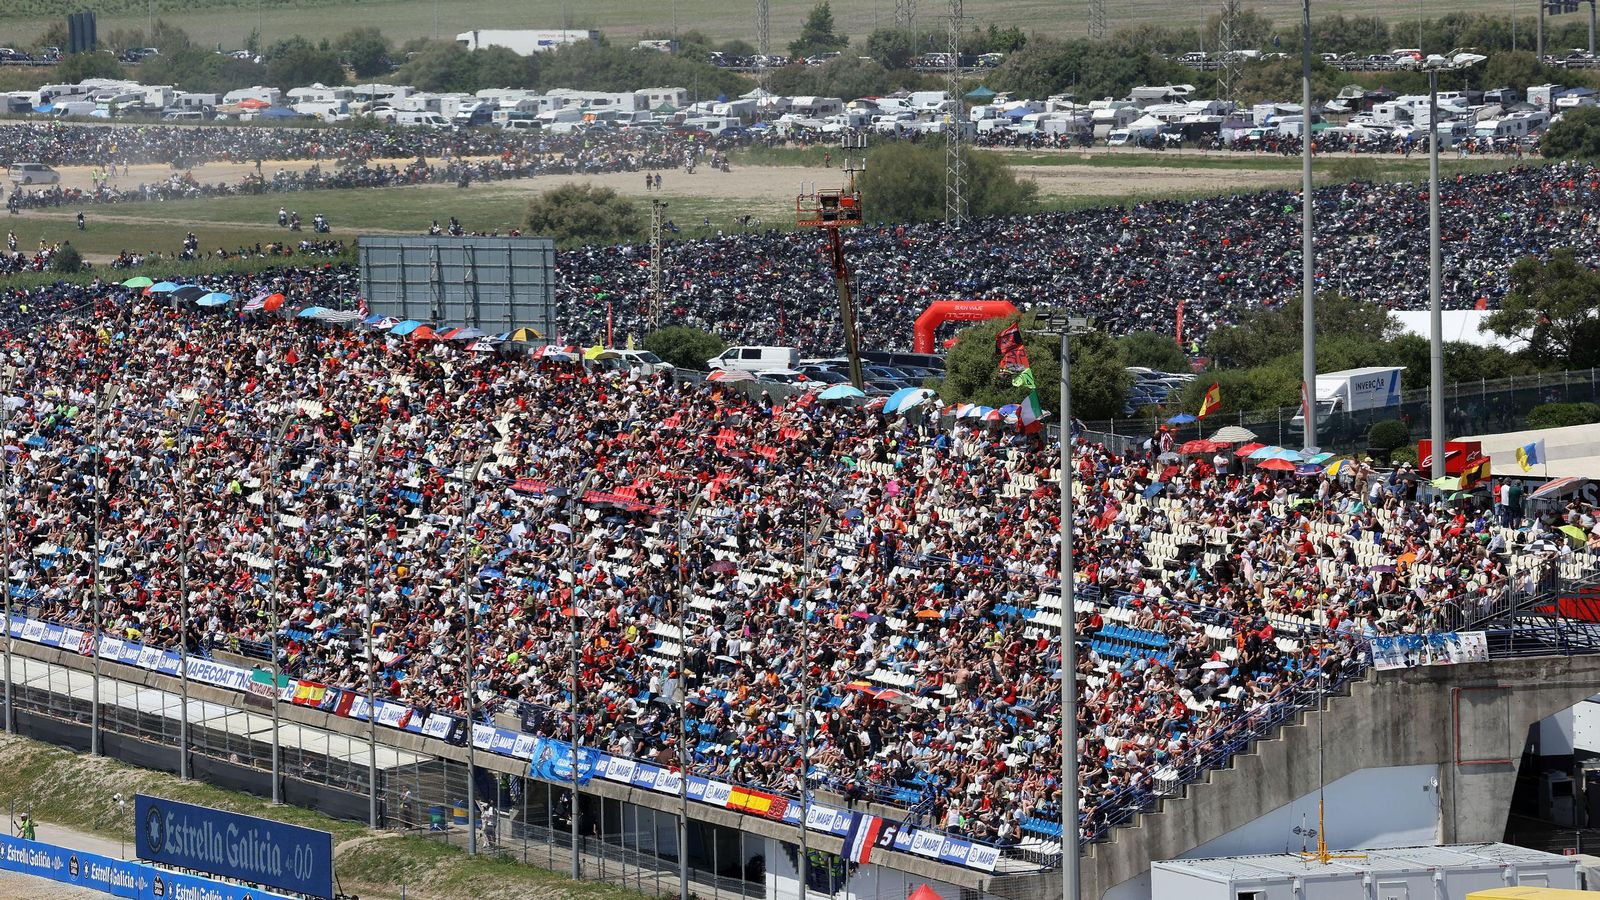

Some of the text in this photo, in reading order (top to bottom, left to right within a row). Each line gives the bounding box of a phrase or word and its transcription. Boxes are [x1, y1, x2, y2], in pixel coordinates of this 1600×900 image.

[1355, 376, 1385, 391] INVERCAR
[186, 660, 235, 685] MAPECOAT
[432, 720, 448, 734] MAPEI
[500, 736, 516, 750] MAPEI
[616, 763, 633, 778] MAPEI
[639, 768, 658, 784] MAPEI
[664, 775, 681, 790] MAPEI
[687, 780, 707, 796] MAPEI
[815, 811, 834, 827] MAPEI
[165, 811, 223, 864] Estrella
[226, 822, 282, 877] Galicia
[880, 827, 897, 847] 5
[922, 837, 941, 852] MAPEI
[949, 844, 968, 860] MAPEI
[976, 852, 997, 866] MAPEI
